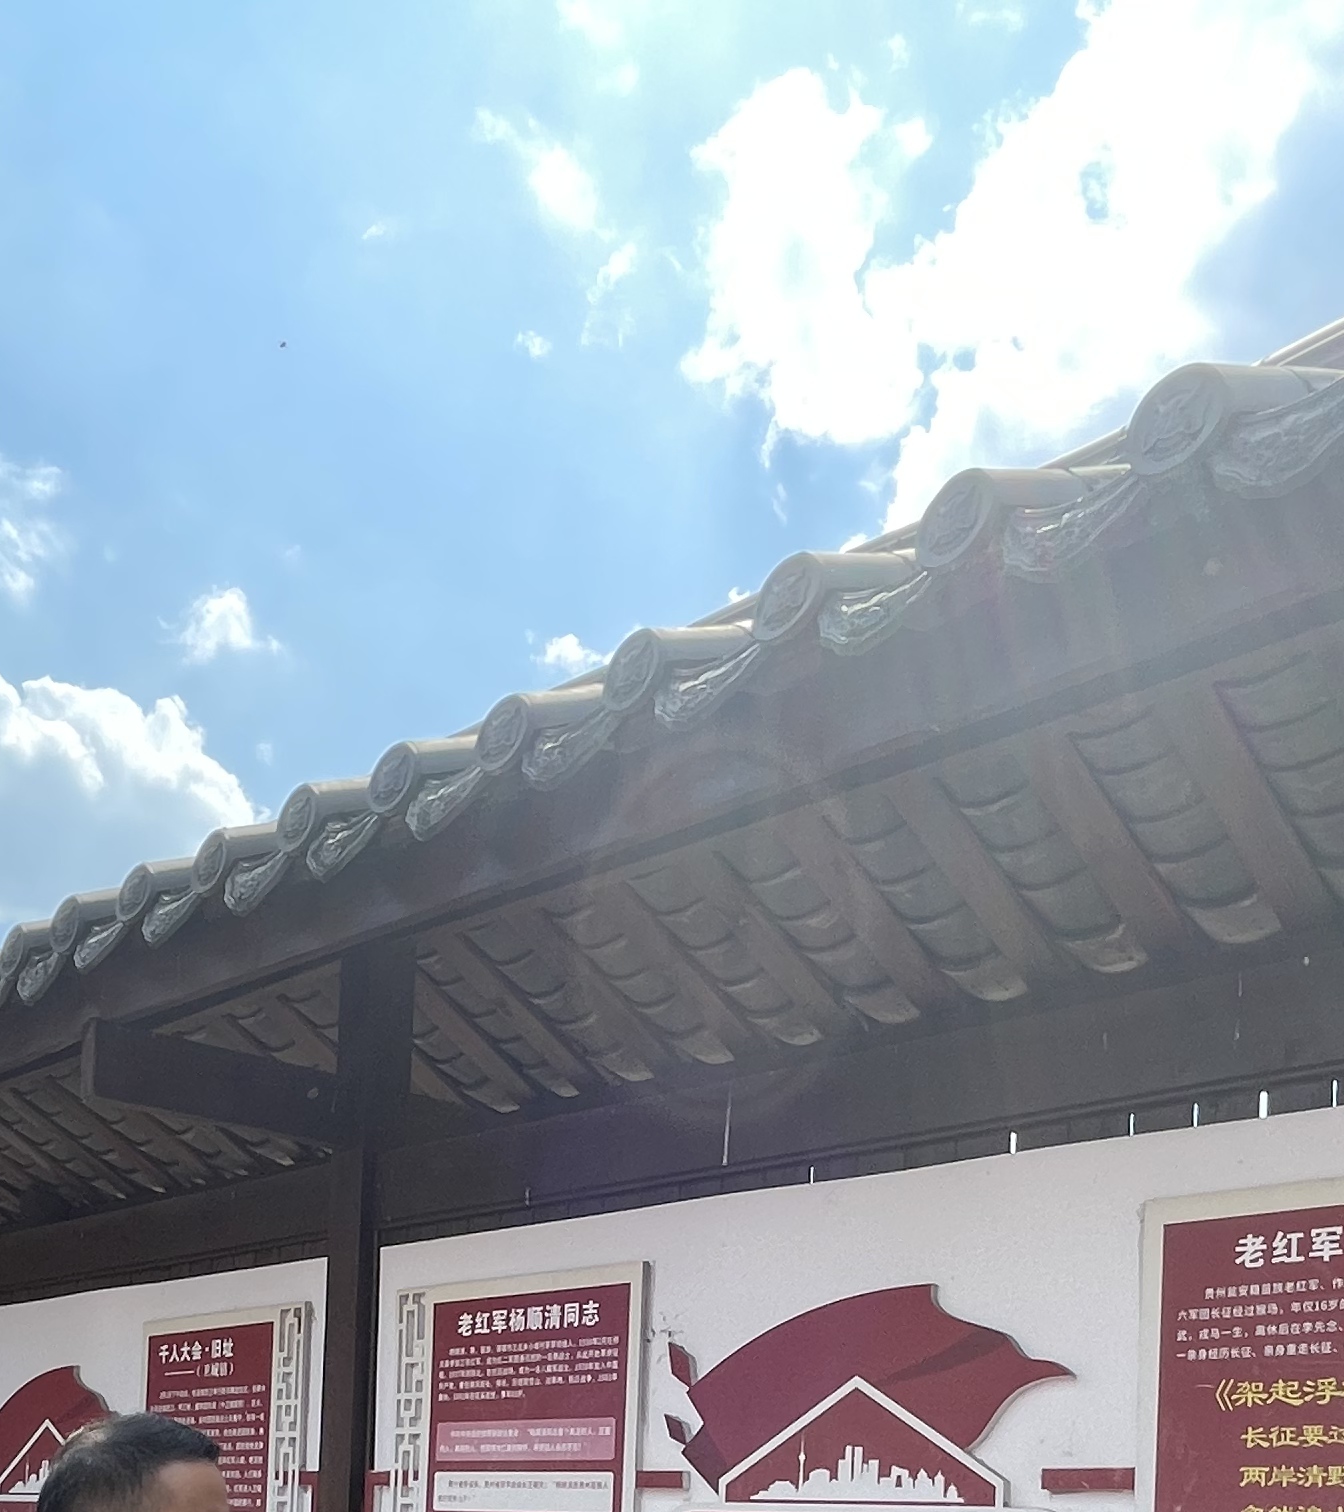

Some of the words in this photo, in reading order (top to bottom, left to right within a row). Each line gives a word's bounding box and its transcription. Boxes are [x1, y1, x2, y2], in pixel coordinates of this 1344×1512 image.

[457, 1300, 601, 1338] 老红军杨顺清同志
